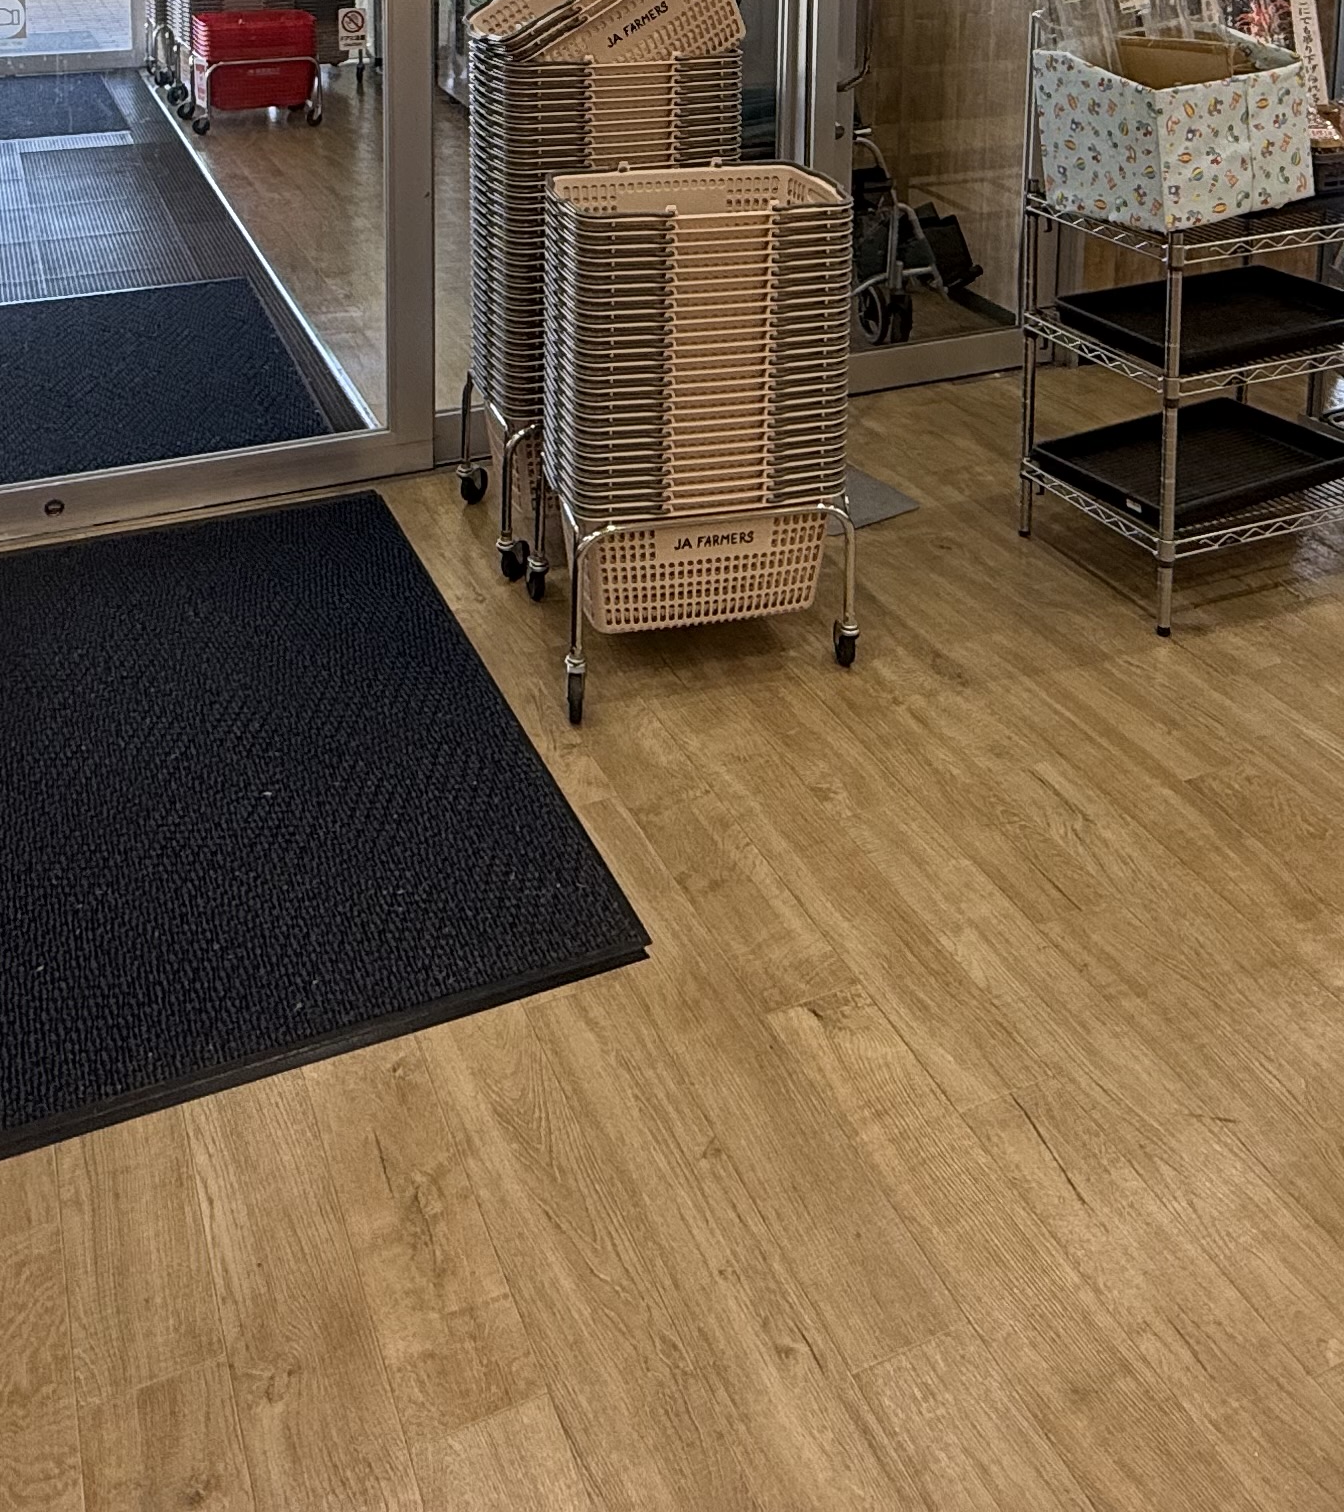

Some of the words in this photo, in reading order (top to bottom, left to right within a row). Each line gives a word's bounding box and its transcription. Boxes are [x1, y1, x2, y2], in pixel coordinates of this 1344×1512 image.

[607, 33, 624, 48] JA
[622, 0, 670, 38] FARMERS
[674, 537, 693, 550] JA
[697, 530, 755, 548] FARMERS
